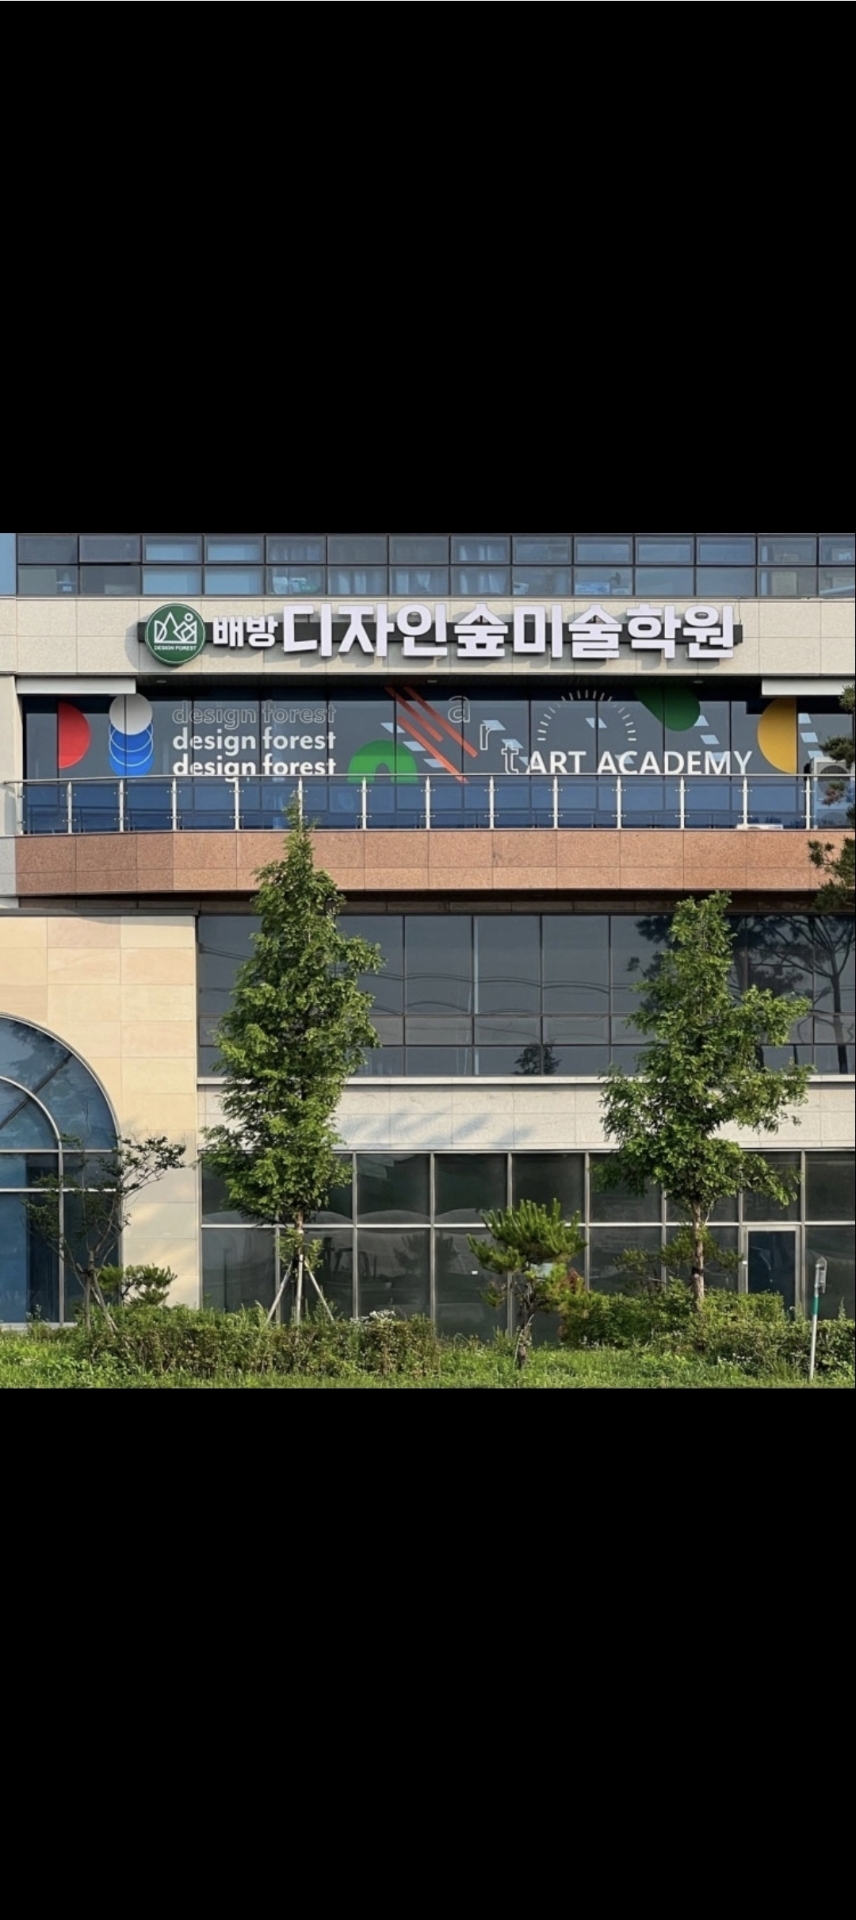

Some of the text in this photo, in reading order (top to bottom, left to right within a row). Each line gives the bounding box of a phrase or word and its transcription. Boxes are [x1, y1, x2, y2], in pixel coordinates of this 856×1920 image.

[212, 602, 734, 659] 배방 디자인숲미술학원
[172, 700, 336, 729] design forest
[172, 727, 336, 756] design forest
[172, 753, 336, 782] design forest
[526, 751, 753, 775] ART ACADEMY
